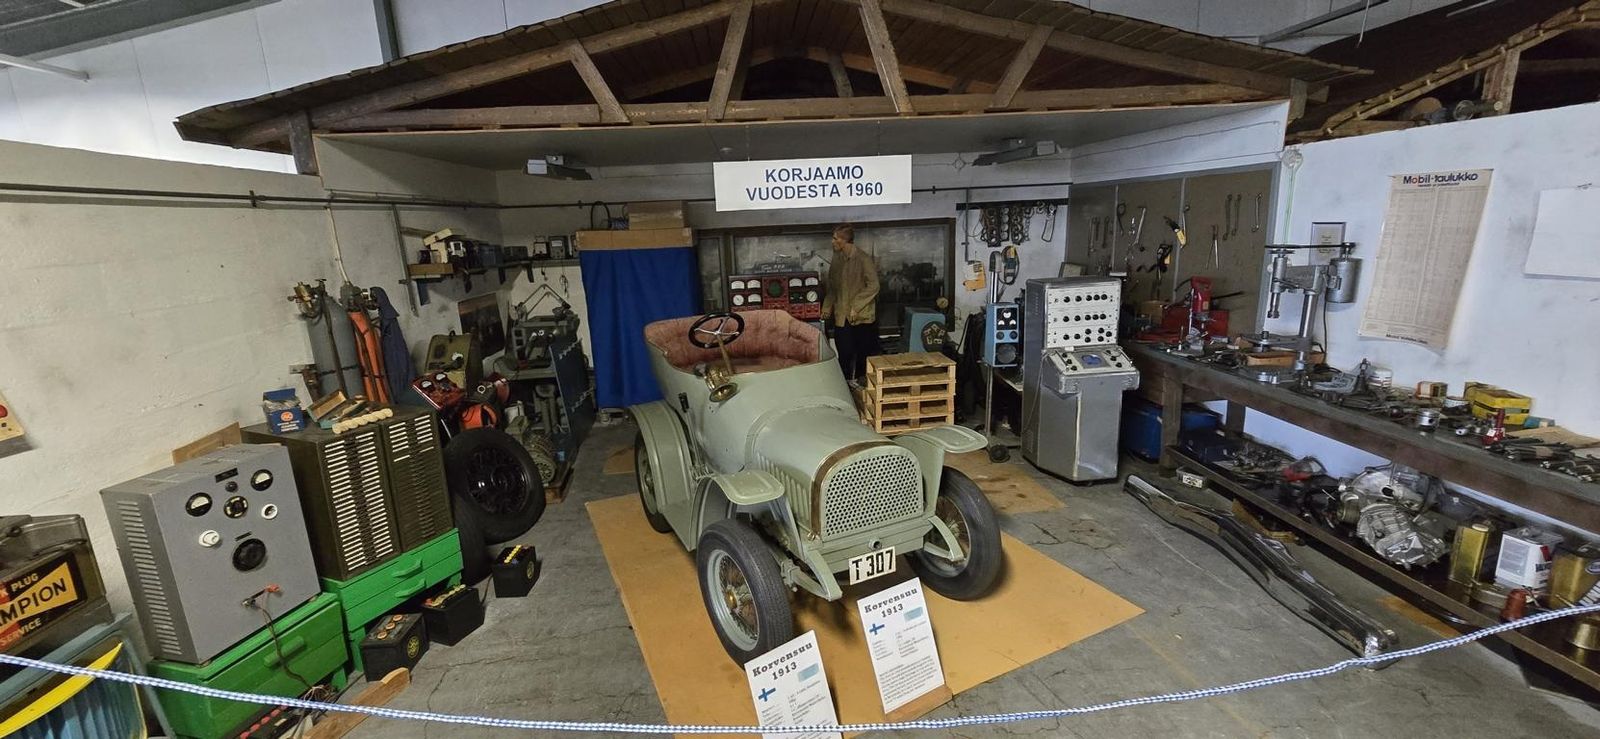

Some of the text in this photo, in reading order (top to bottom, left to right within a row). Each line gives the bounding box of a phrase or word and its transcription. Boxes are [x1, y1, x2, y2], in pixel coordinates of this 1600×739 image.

[765, 165, 863, 183] KORJAAMO
[746, 181, 883, 201] VUODESTA 1960
[852, 549, 894, 581] T 307
[10, 573, 39, 592] PLUG
[864, 587, 918, 614] Korvensuu
[881, 603, 904, 618] 1913
[752, 642, 813, 677] Korvensuu
[772, 661, 797, 680] 1913
